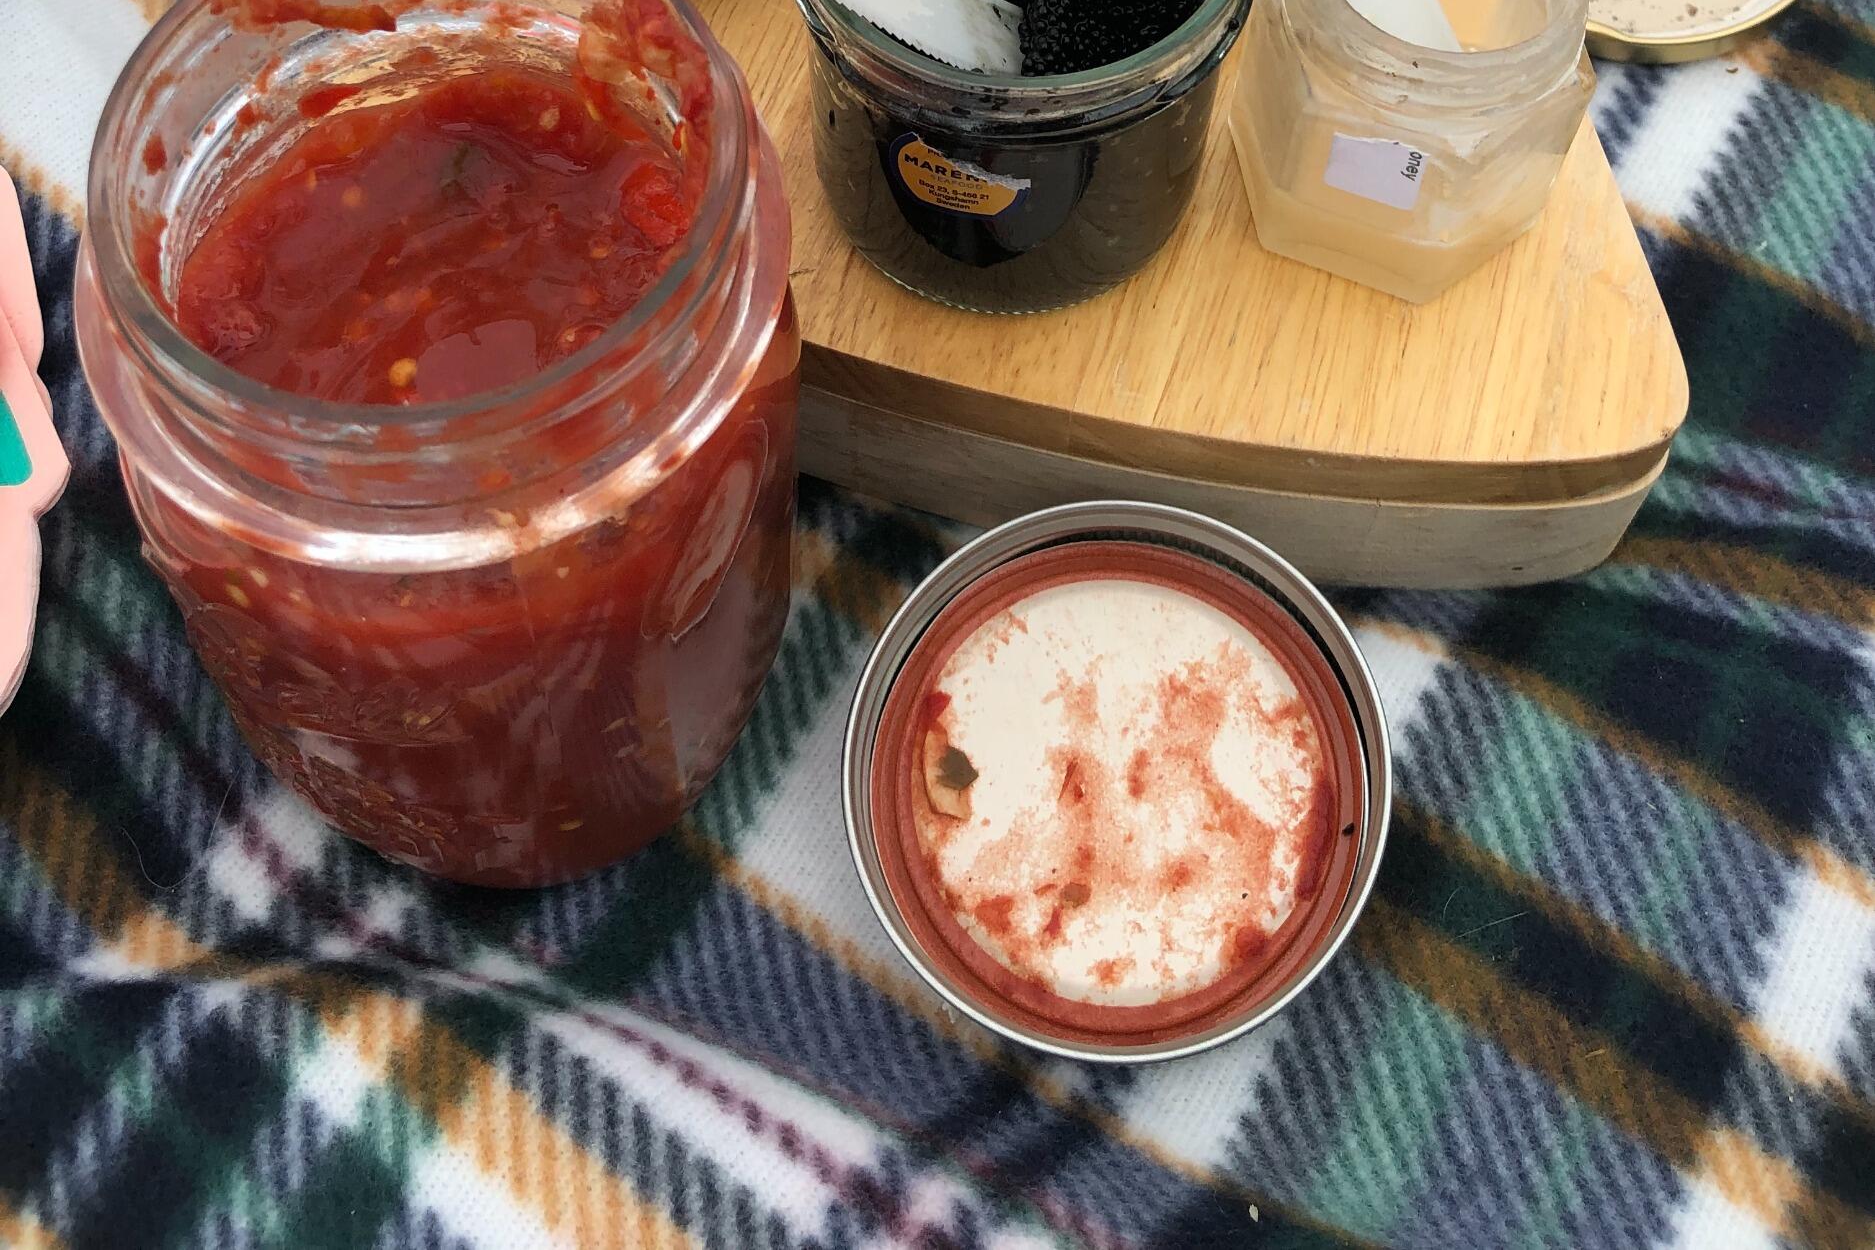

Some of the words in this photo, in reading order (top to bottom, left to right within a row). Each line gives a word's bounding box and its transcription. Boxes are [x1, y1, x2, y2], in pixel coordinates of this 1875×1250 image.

[903, 153, 988, 183] MAREN
[1400, 151, 1423, 182] oney
[919, 179, 935, 190] Box
[980, 193, 990, 201] 21
[928, 188, 979, 206] Kungshamn
[936, 197, 971, 210] Sweden
